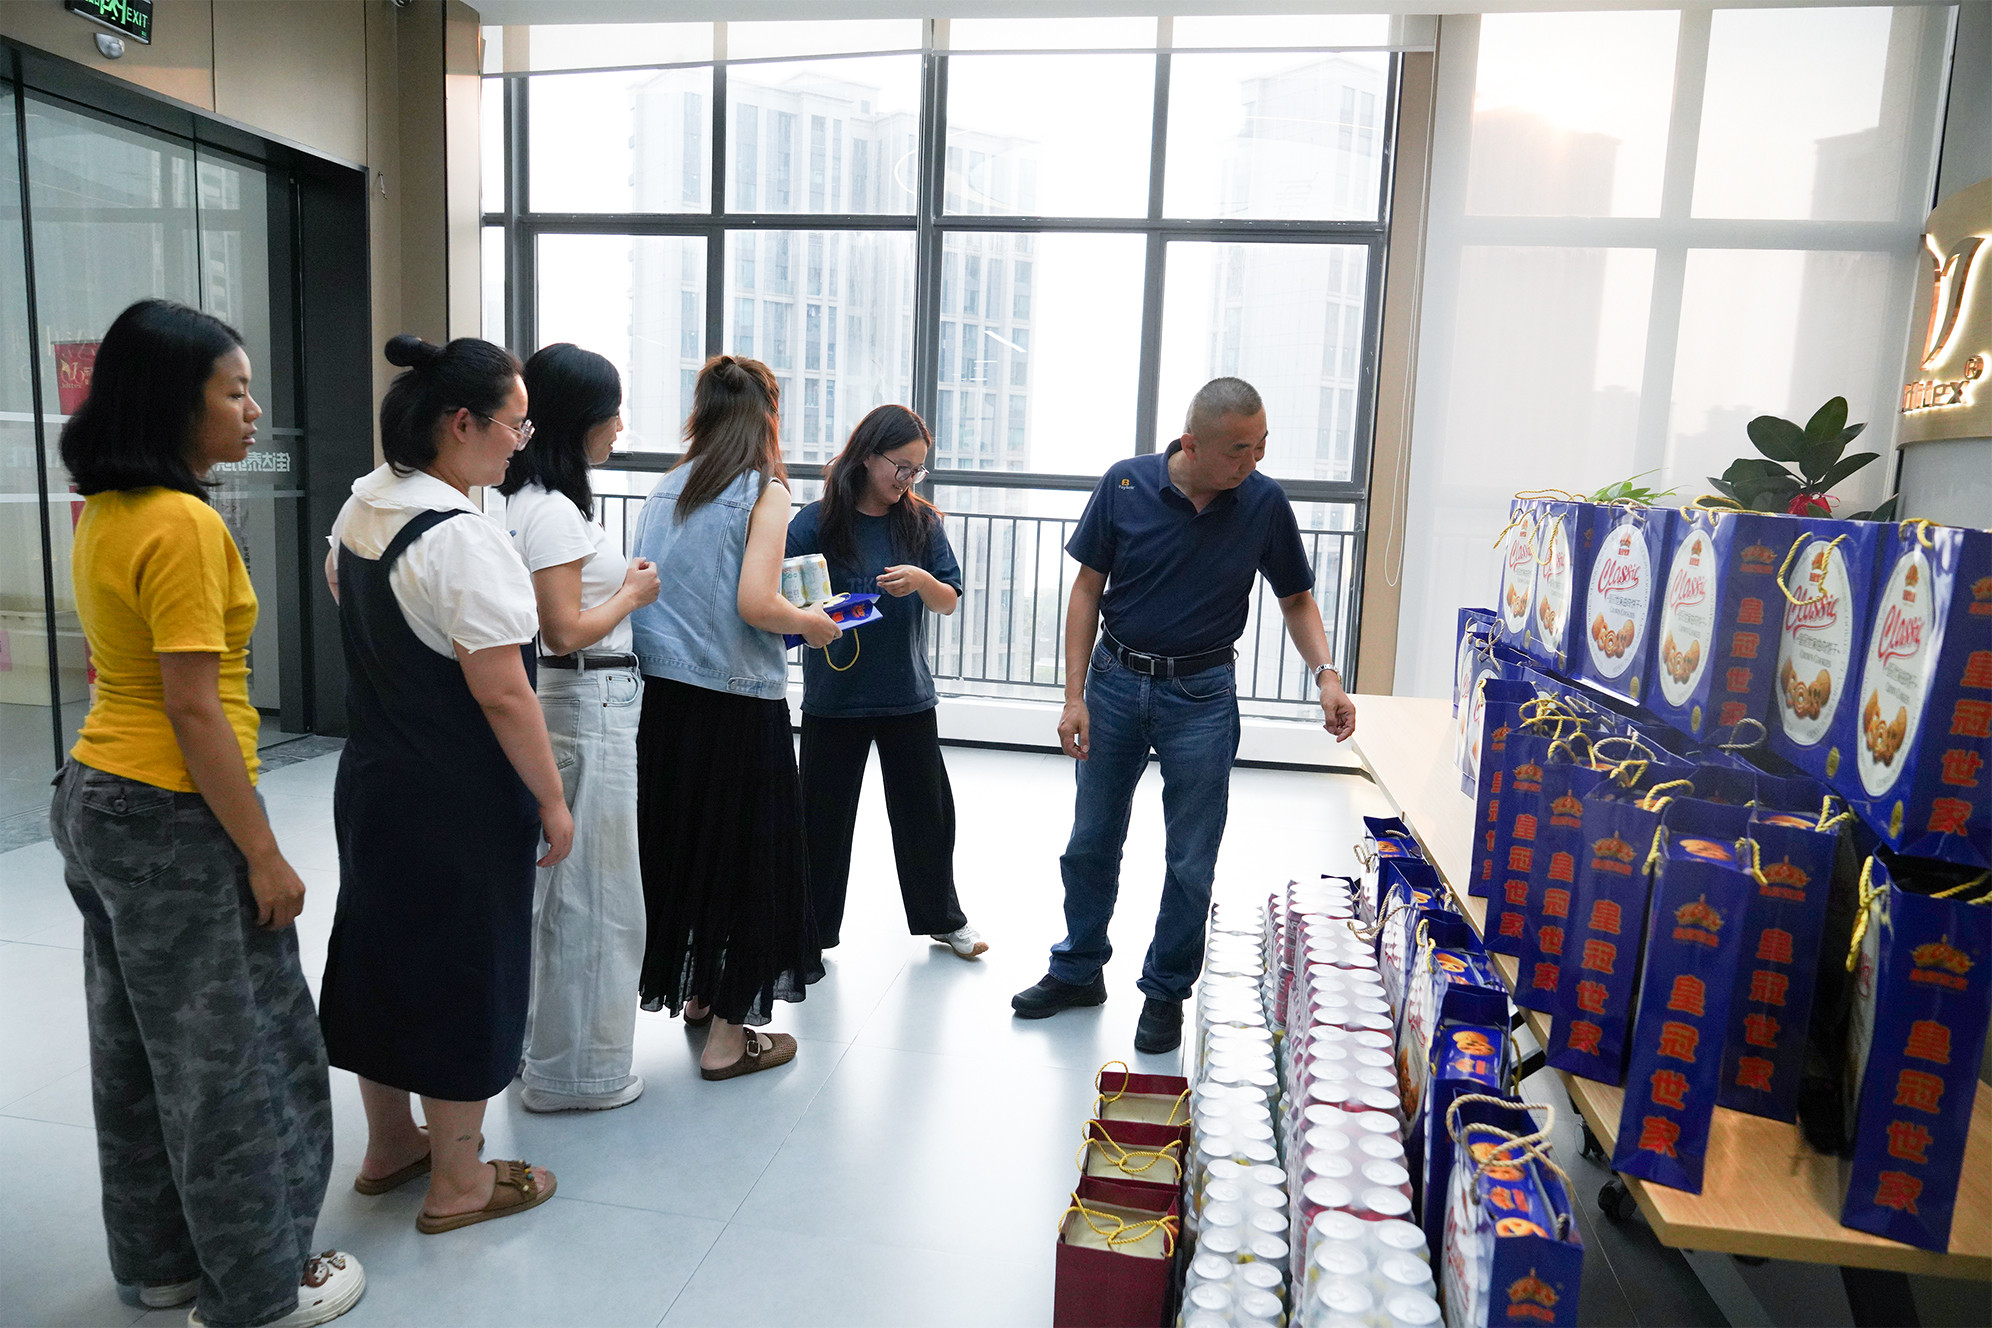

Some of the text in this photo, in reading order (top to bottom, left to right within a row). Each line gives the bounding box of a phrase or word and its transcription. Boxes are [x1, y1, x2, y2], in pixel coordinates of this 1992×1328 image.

[127, 6, 148, 28] EXIT
[1598, 558, 1640, 598] Classic
[1670, 569, 1706, 614] Classic
[1785, 585, 1839, 639] Classic
[1878, 605, 1925, 667] Classic
[1719, 597, 1764, 726] 皇冠世家
[1500, 814, 1537, 938] 皇冠世家
[1533, 852, 1574, 992] 皇冠世家
[1568, 900, 1621, 1057] 皇冠世家
[1736, 928, 1793, 1092] 皇冠世家
[1638, 974, 1706, 1158] 皇冠世家
[1874, 1020, 1950, 1215] 皇冠世家
